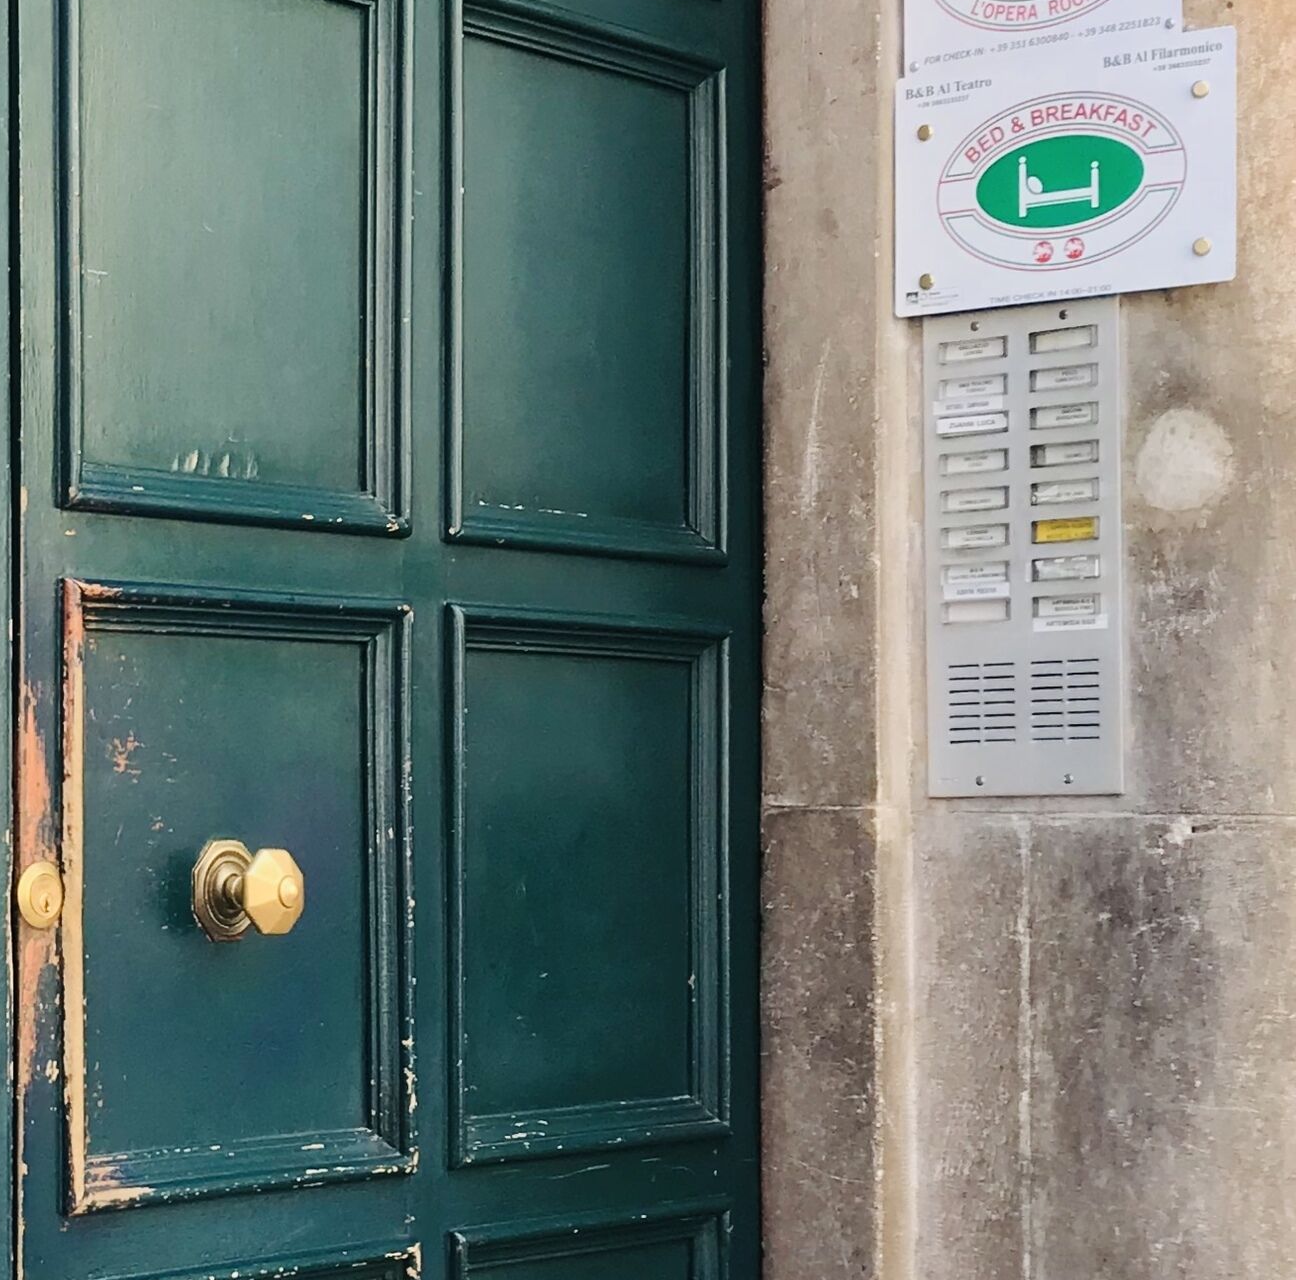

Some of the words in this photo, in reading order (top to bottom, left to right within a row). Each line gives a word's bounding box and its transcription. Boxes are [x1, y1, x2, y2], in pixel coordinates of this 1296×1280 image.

[970, 0, 1038, 22] L'OPERA
[923, 53, 941, 66] FOR
[989, 43, 1008, 54] +39
[1010, 39, 1027, 51] 351
[1077, 26, 1097, 38] +39
[1098, 23, 1117, 35] 348
[1118, 17, 1161, 32] 2251823
[1103, 53, 1132, 68] B&B
[1135, 51, 1148, 63] Al
[1151, 41, 1223, 61] Filarmonico
[905, 85, 935, 100] B&B
[937, 83, 951, 95] Al
[954, 79, 992, 93] Teatro
[963, 126, 1005, 165] BED
[1010, 116, 1025, 134] &
[1030, 102, 1158, 139] BREAKFAST
[989, 295, 1009, 305] TIME
[1012, 292, 1045, 302] CHECK
